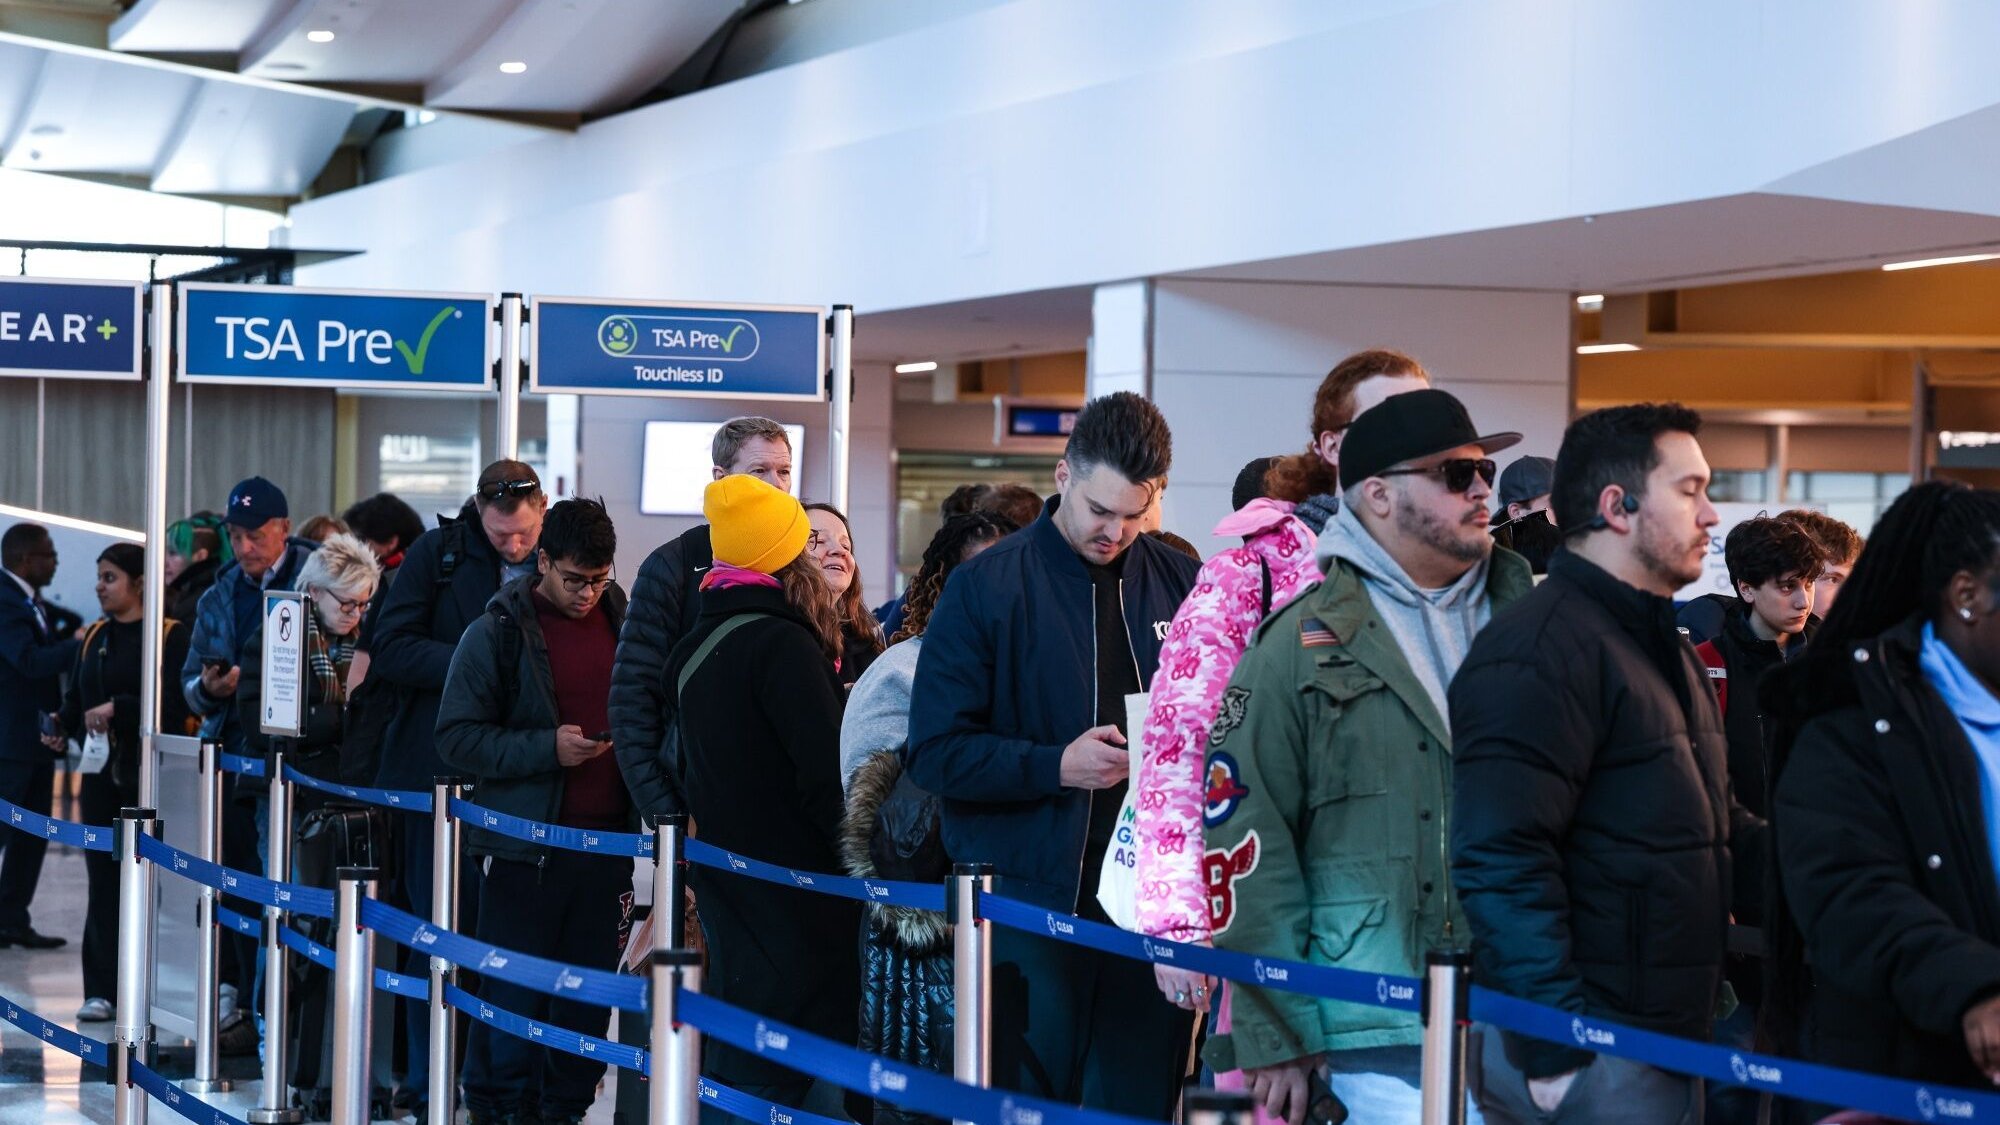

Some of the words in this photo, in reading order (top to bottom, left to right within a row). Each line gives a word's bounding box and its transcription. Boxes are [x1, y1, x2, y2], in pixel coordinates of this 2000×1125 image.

[215, 316, 305, 361] TSA
[318, 320, 393, 364] Pre
[652, 329, 686, 347] TSA
[690, 330, 719, 349] Pre
[633, 365, 704, 383] Touchless
[707, 368, 723, 383] ID
[873, 886, 889, 897] CLEAR
[1056, 920, 1074, 935] CLEAR
[1154, 945, 1174, 959] CLEAR
[1265, 966, 1289, 981] CLEAR
[1389, 984, 1414, 1000] CLEAR
[1585, 1027, 1616, 1046] CLEAR
[705, 1086, 718, 1099] CLEAR
[777, 1113, 792, 1125] CLEAR
